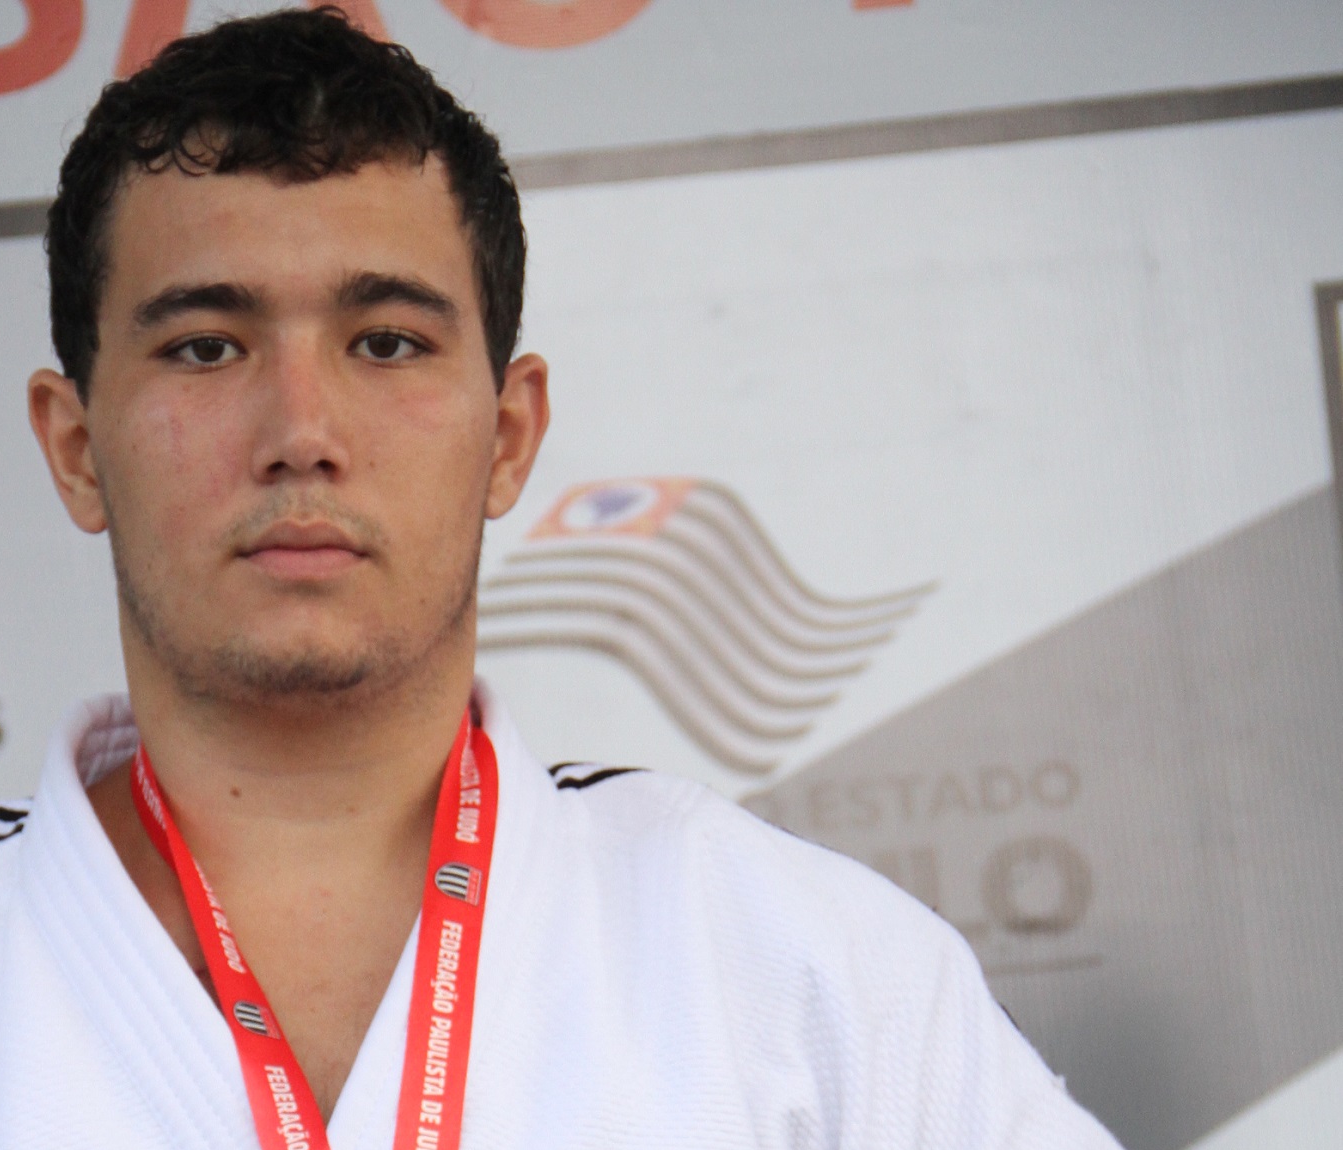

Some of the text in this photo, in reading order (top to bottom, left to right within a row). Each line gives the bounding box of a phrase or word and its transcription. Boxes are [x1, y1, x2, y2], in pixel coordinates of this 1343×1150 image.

[806, 759, 1083, 829] ESTADO
[430, 919, 463, 1014] FEDERAÇÃO
[422, 1015, 452, 1096] PAULISTA
[419, 1099, 442, 1125] DE
